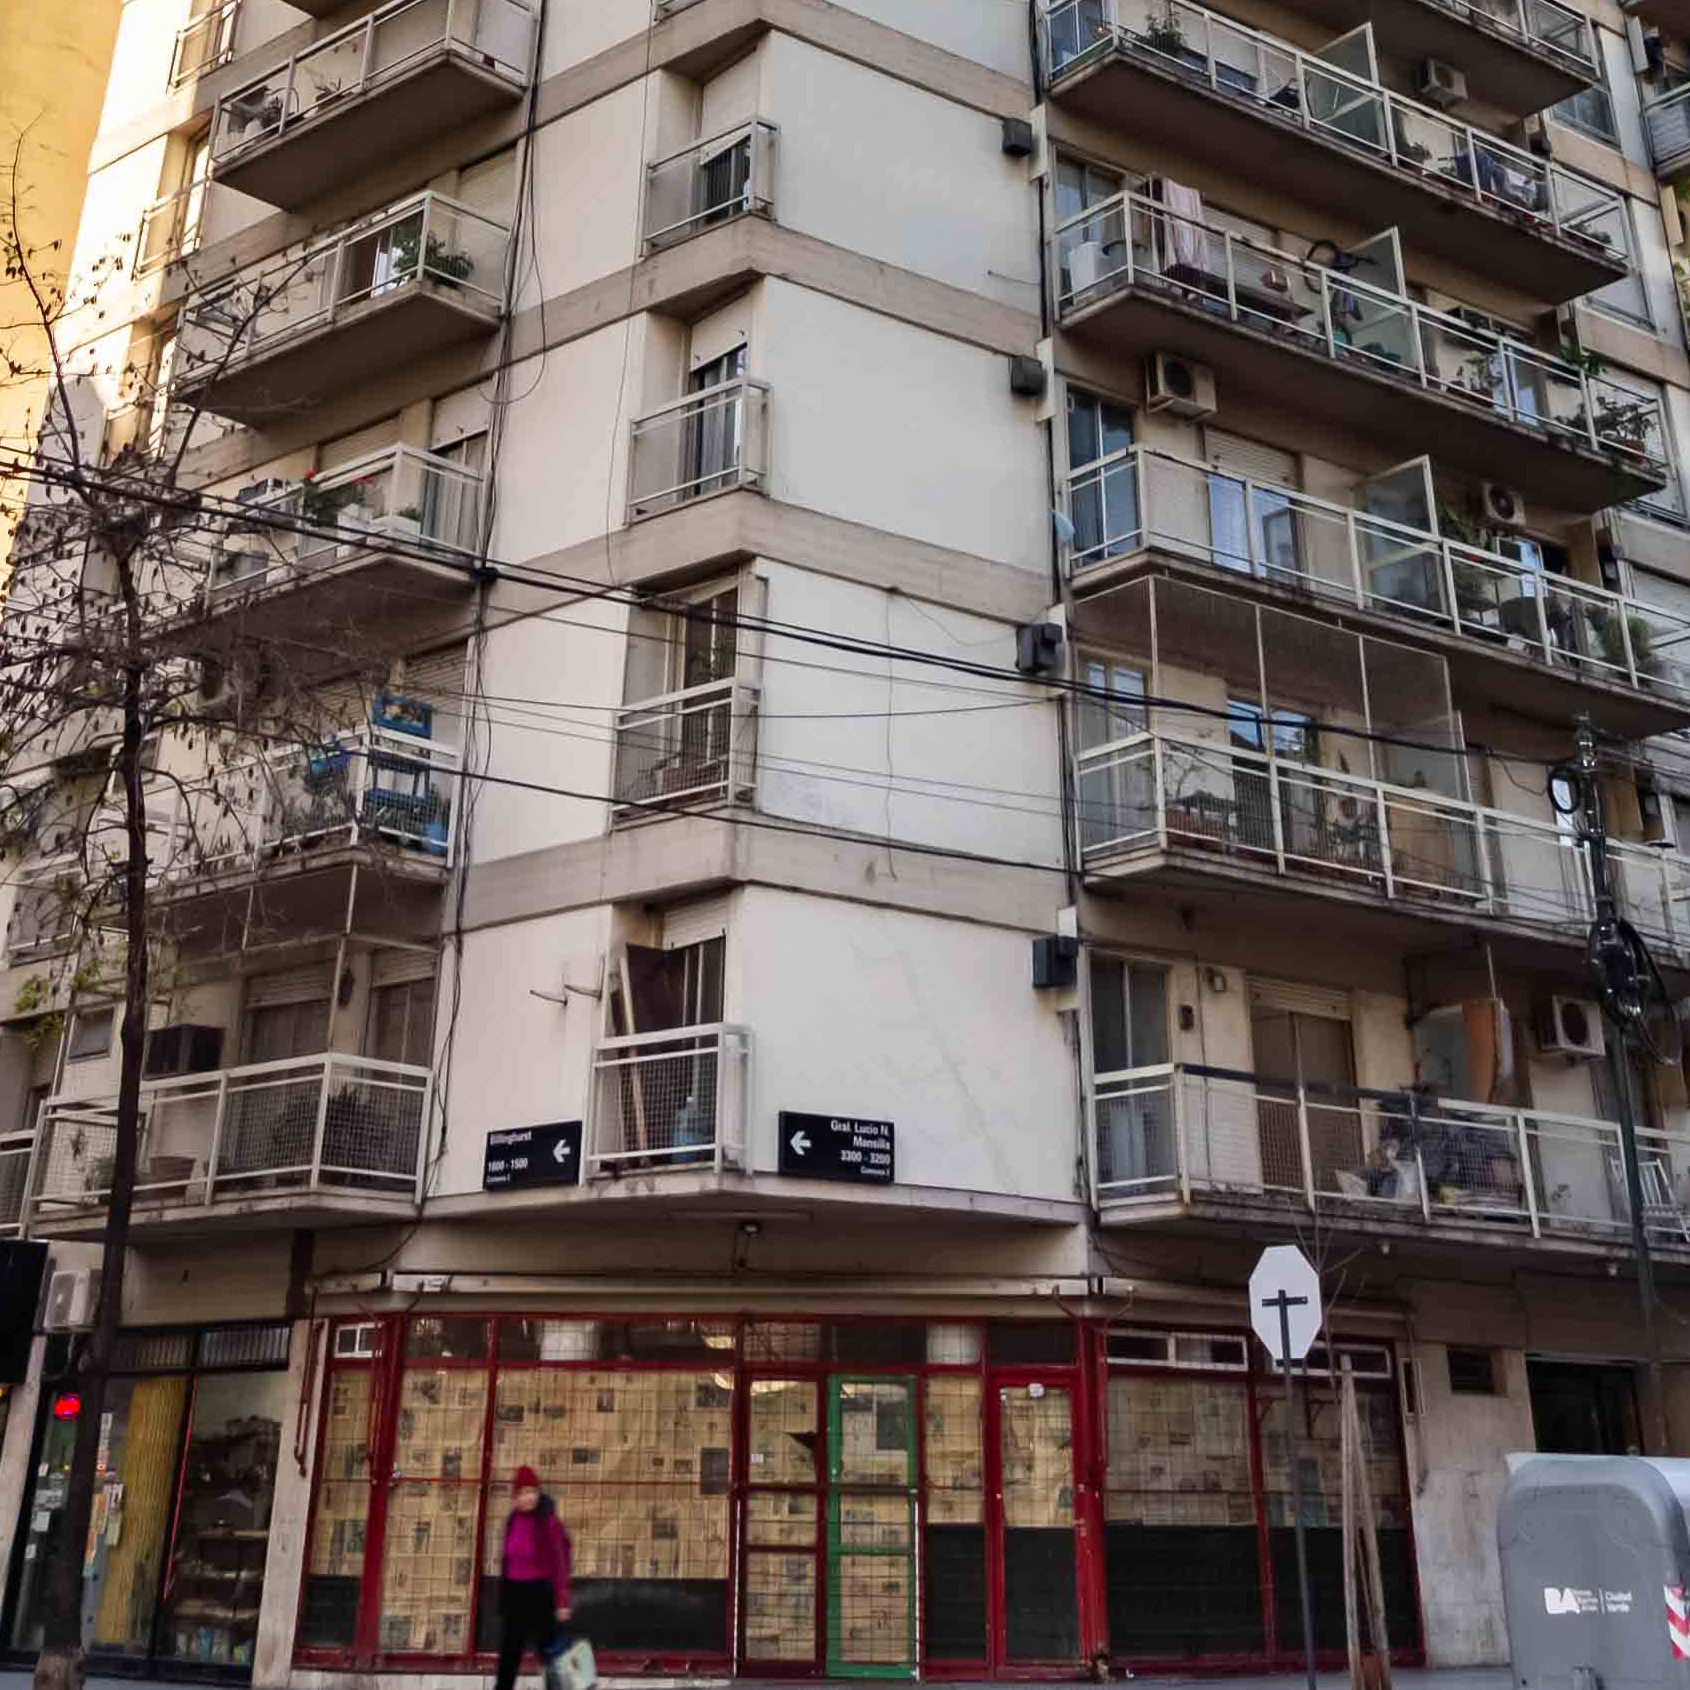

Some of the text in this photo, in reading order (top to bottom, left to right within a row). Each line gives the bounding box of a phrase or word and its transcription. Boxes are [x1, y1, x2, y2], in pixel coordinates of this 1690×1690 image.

[830, 1119, 852, 1132] Gral.
[854, 1121, 879, 1135] Lucio
[853, 1135, 891, 1150] Mansilla
[840, 1149, 863, 1163] 3300
